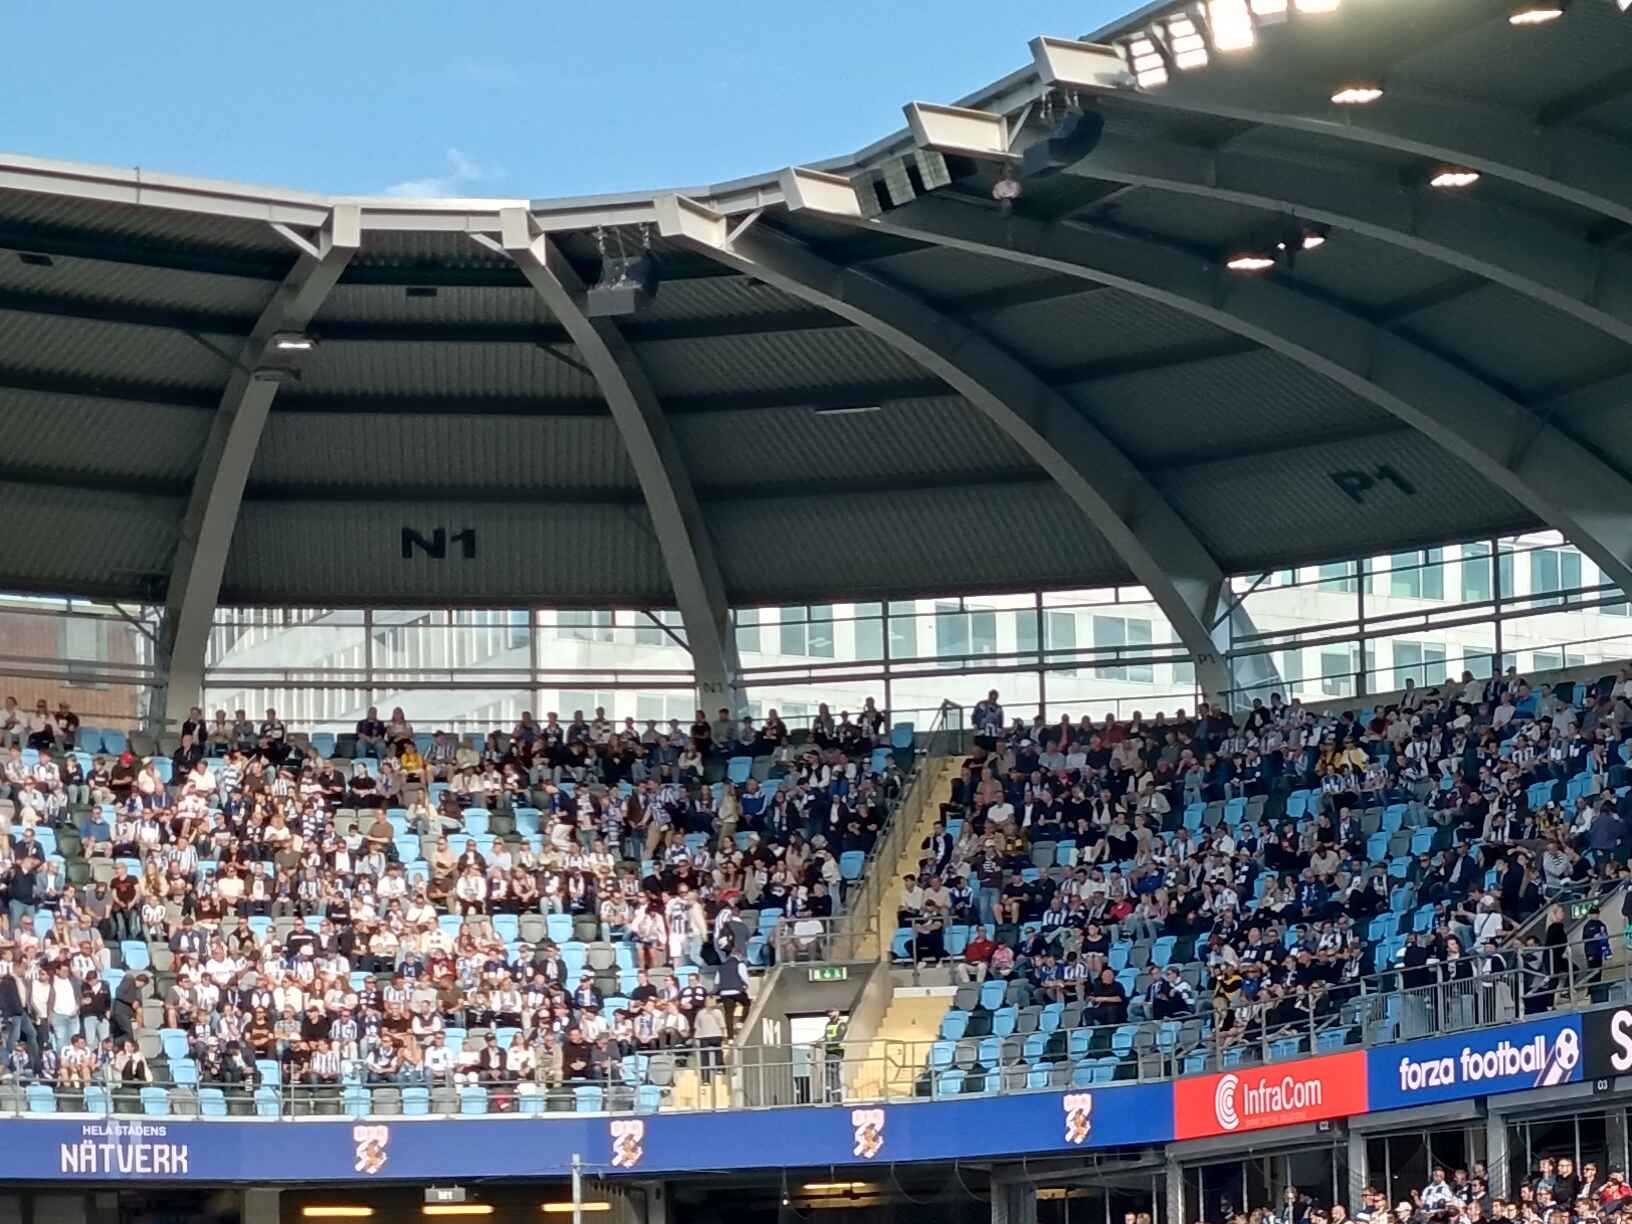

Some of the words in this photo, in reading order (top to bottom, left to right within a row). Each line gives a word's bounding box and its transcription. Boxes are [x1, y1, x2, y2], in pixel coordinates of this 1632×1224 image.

[1328, 464, 1417, 502] P1
[401, 527, 477, 560] N1
[1400, 1057, 1454, 1091] forza
[1461, 1035, 1546, 1082] football
[1243, 1076, 1322, 1116] InfraCom
[83, 1125, 112, 1137] HELA
[115, 1125, 167, 1137] STADENS
[61, 1139, 188, 1174] NÄTVERK
